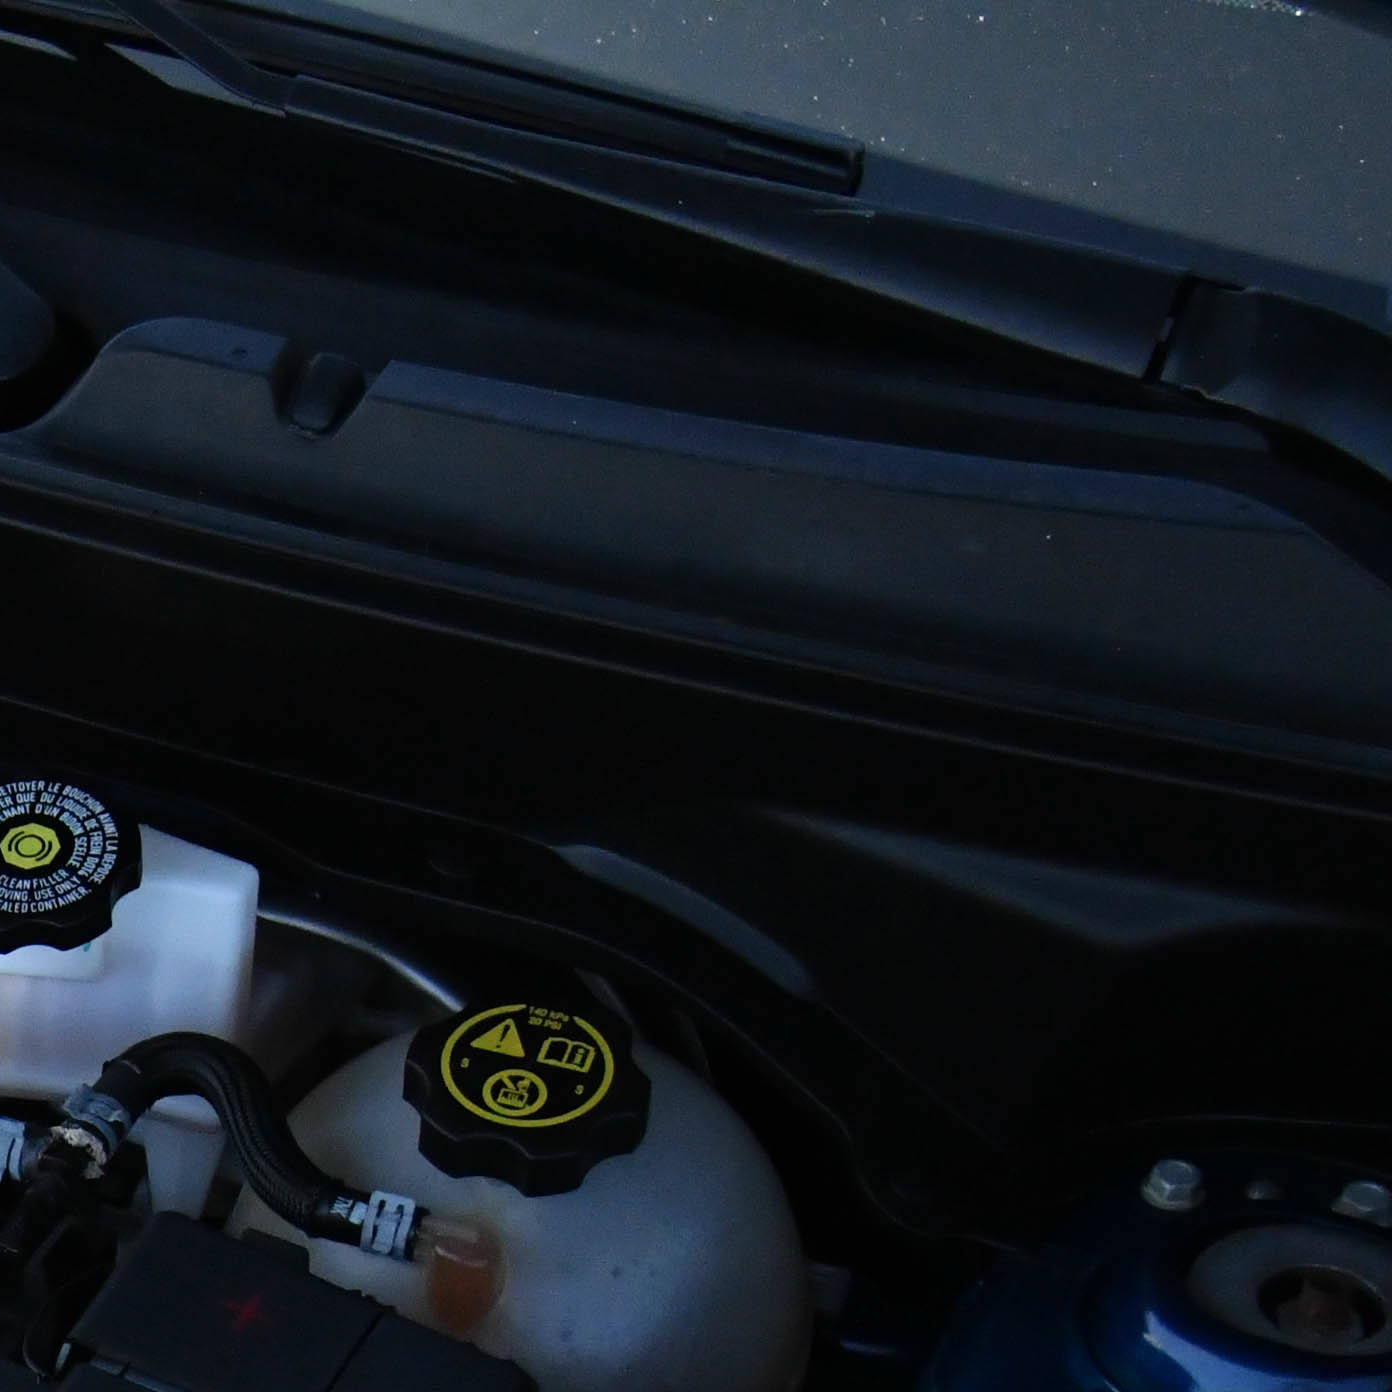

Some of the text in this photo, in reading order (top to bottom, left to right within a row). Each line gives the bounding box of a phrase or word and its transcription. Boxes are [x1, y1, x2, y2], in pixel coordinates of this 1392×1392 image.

[48, 781, 62, 793] LE
[62, 784, 105, 813] BOUCHON
[16, 792, 36, 802] QUE
[40, 793, 55, 803] DU
[55, 795, 92, 822] LIQUIDE
[84, 817, 99, 833] DE
[97, 807, 119, 839] AVANT
[105, 840, 119, 852] LA
[33, 868, 70, 889] FILLER
[35, 887, 54, 900] USE
[55, 875, 81, 895] ONLY
